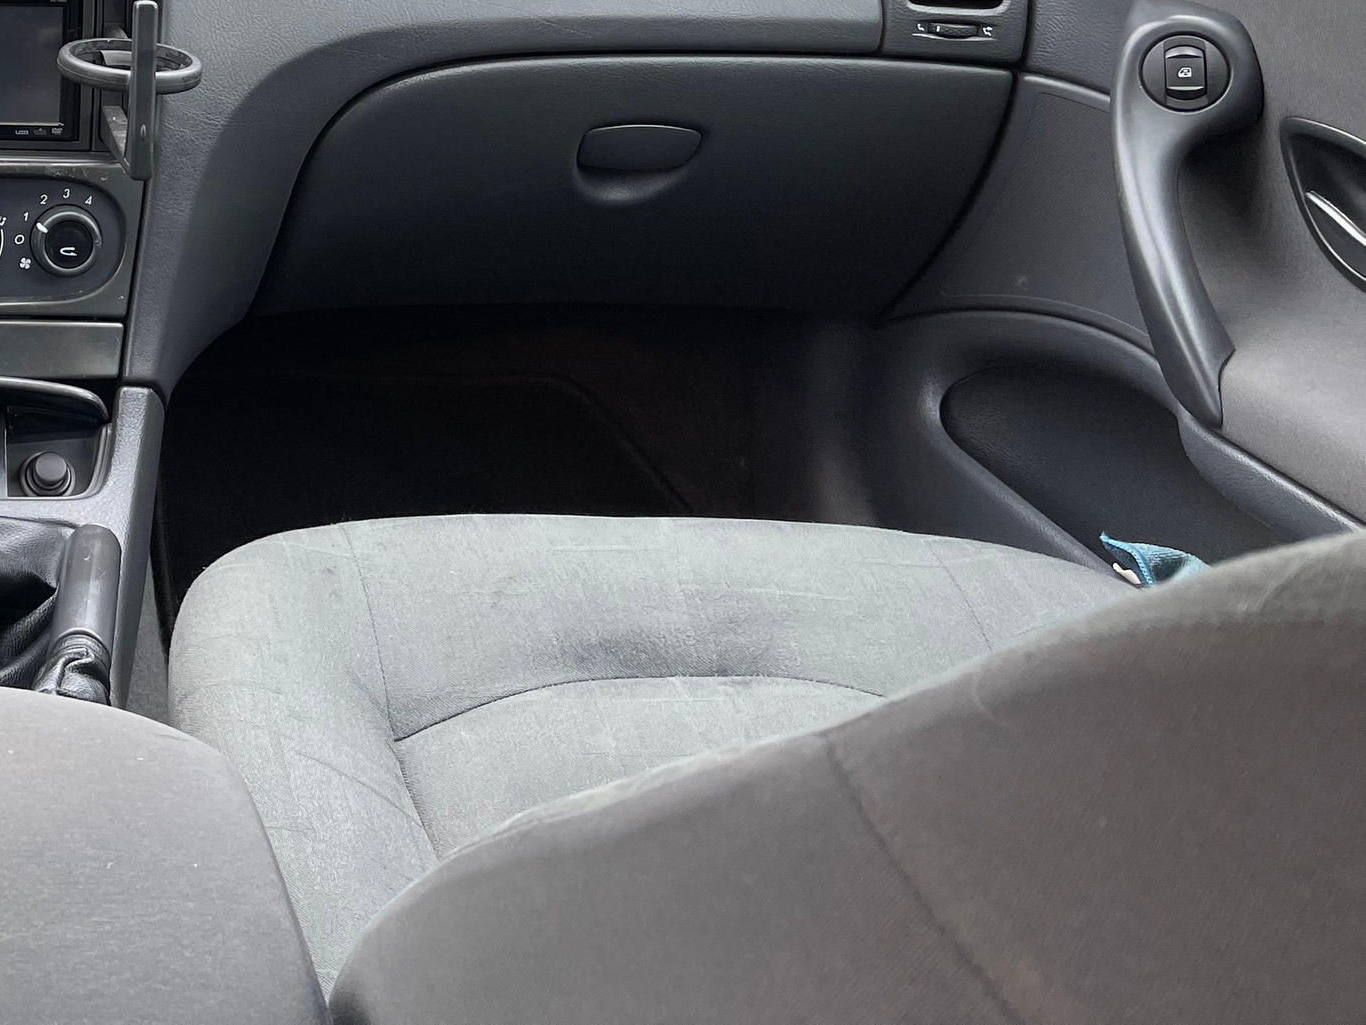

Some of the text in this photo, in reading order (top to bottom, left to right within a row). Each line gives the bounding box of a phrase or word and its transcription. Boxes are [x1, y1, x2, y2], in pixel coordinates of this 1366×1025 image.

[62, 188, 71, 199] 3
[40, 194, 48, 205] 2
[84, 195, 93, 206] 4
[23, 211, 29, 222] 1
